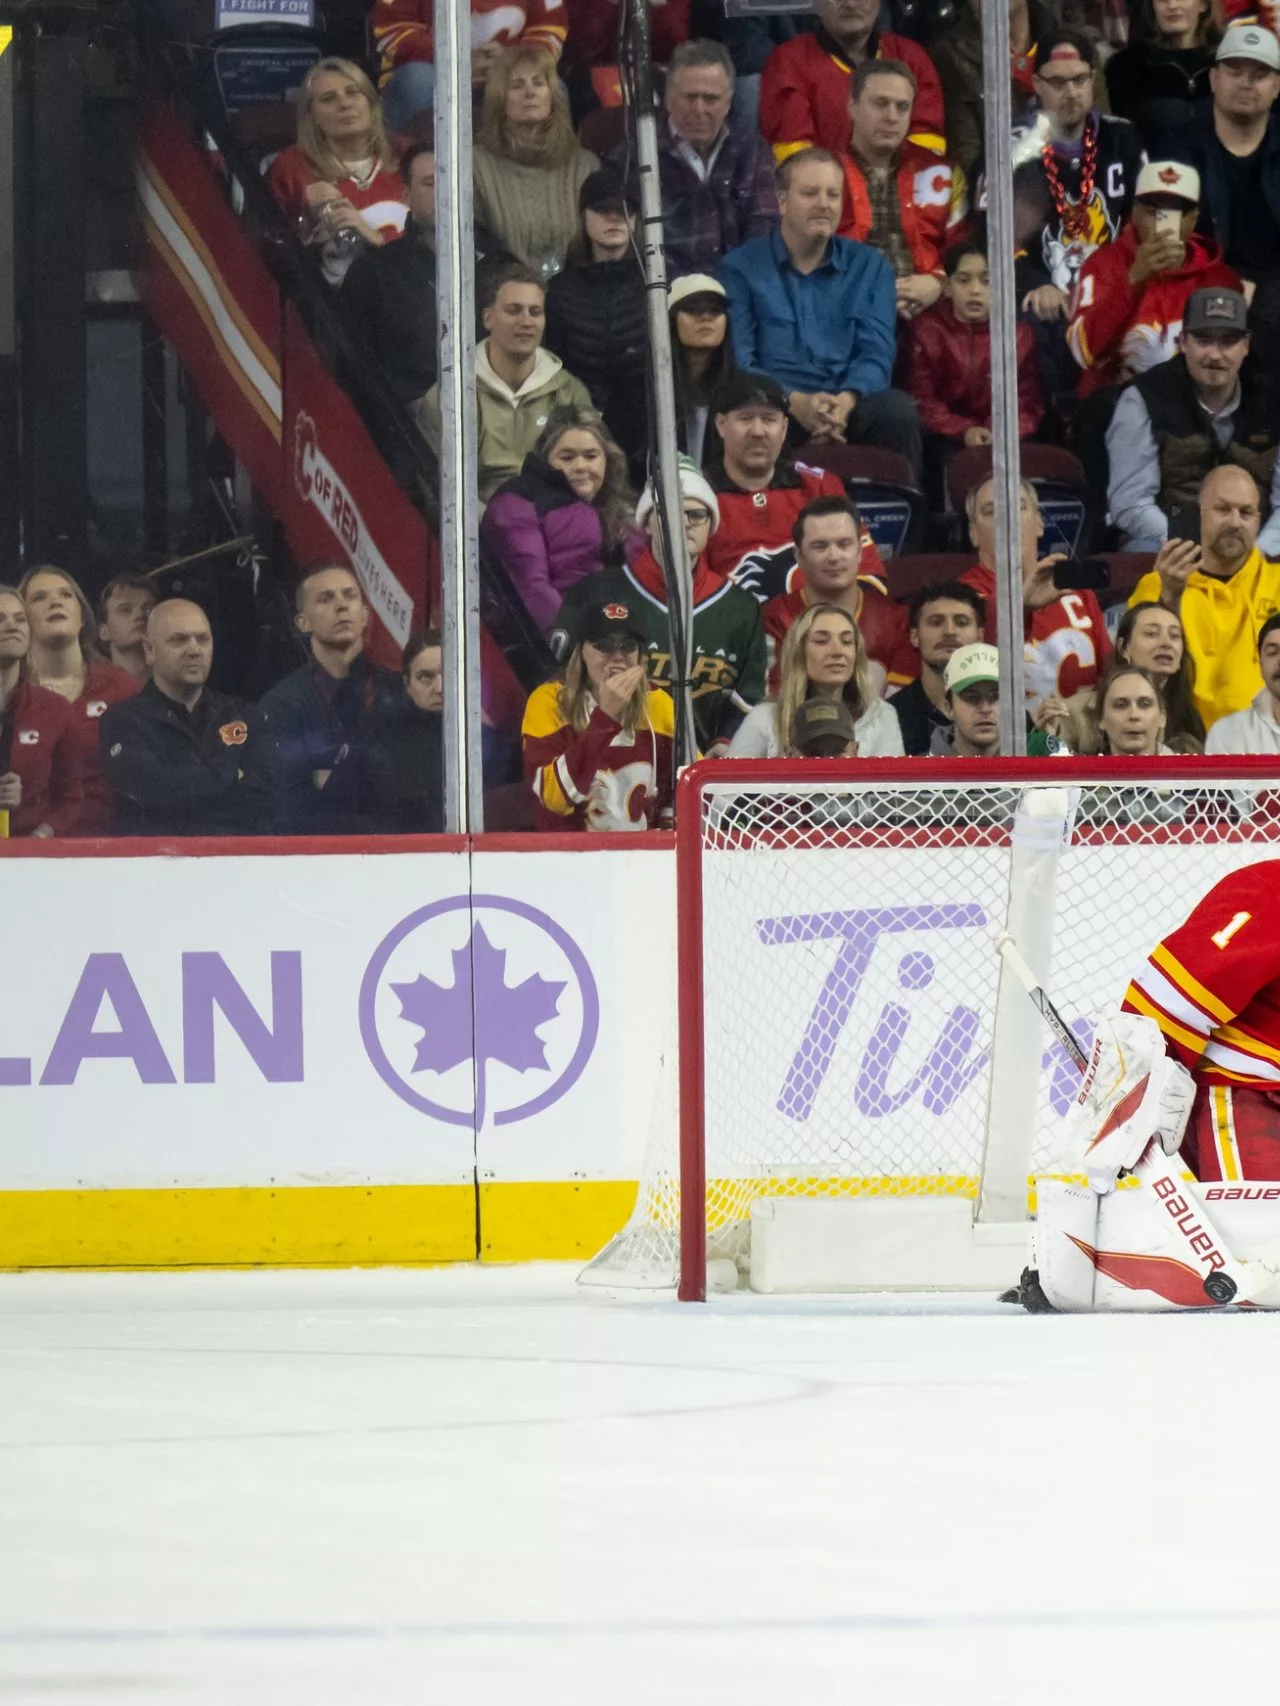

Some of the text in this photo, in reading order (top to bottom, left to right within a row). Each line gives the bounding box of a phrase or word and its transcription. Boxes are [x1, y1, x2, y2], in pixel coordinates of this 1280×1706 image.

[231, 0, 275, 12] FIGHT
[280, 0, 309, 12] FOR
[1107, 163, 1125, 198] C
[314, 468, 333, 502] OF
[331, 486, 359, 555] RED
[1060, 594, 1092, 629] C
[959, 650, 998, 672] ALLAS
[1211, 911, 1252, 950] 1
